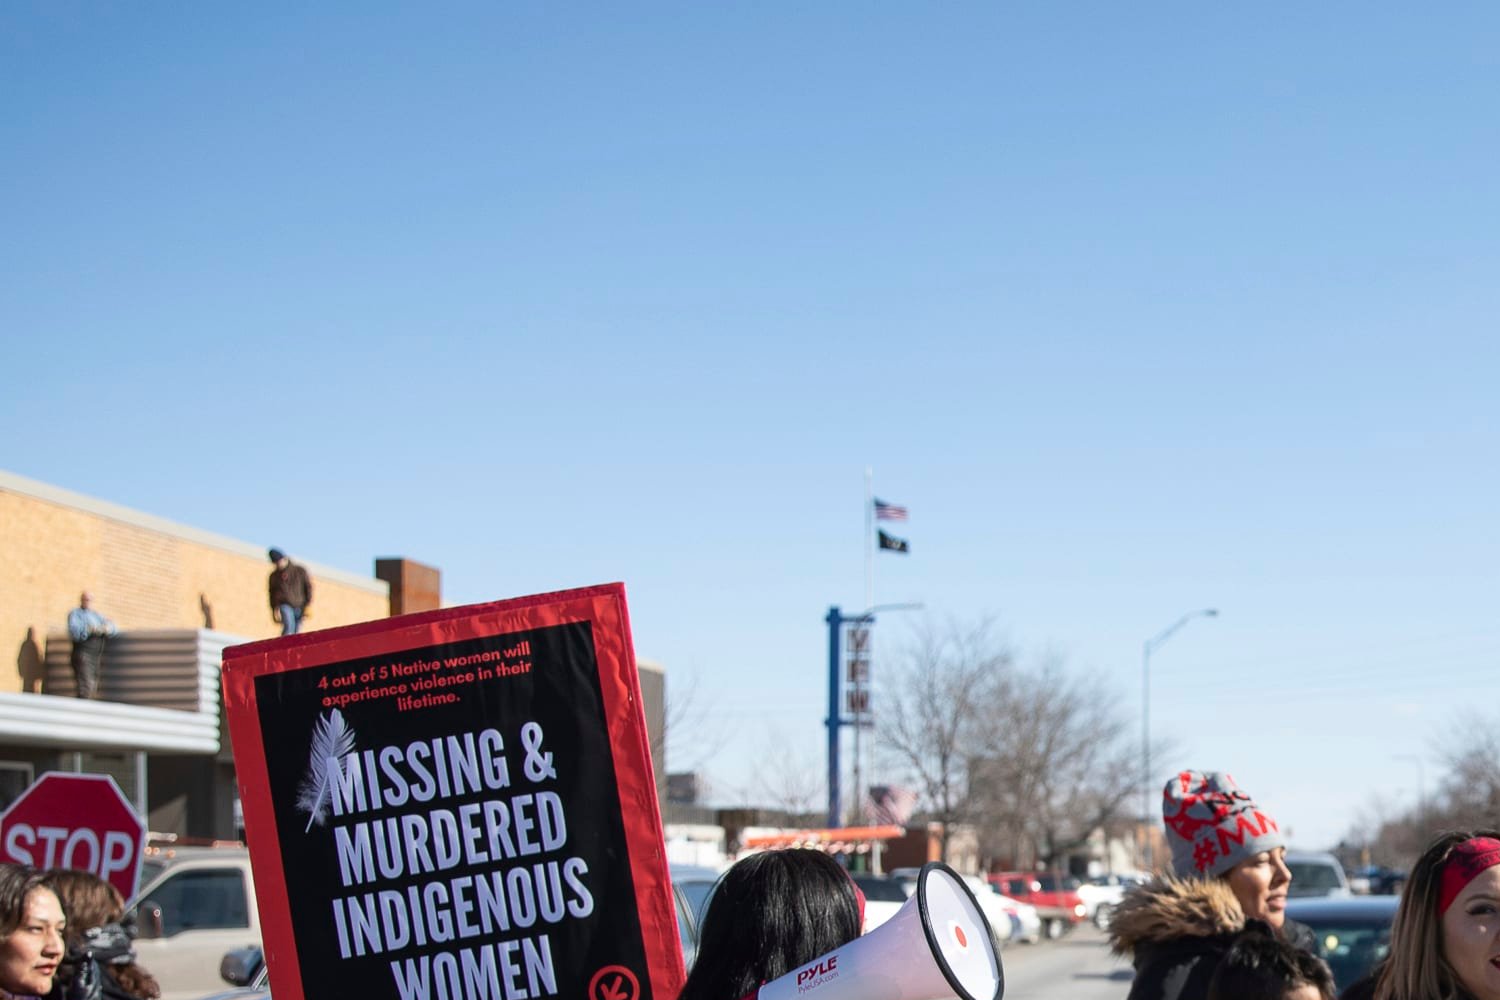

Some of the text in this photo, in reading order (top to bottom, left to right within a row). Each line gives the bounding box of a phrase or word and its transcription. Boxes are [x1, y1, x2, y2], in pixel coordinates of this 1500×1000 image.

[317, 641, 531, 689] 4 out of 5 Native women will
[322, 660, 532, 708] experience violence in their
[397, 692, 461, 711] lifetime.
[325, 721, 557, 817] MISSING &
[5, 823, 134, 883] STOP
[334, 791, 567, 887] MURDERED
[332, 856, 594, 959] INDIGENOUS
[797, 955, 839, 985] PYLE
